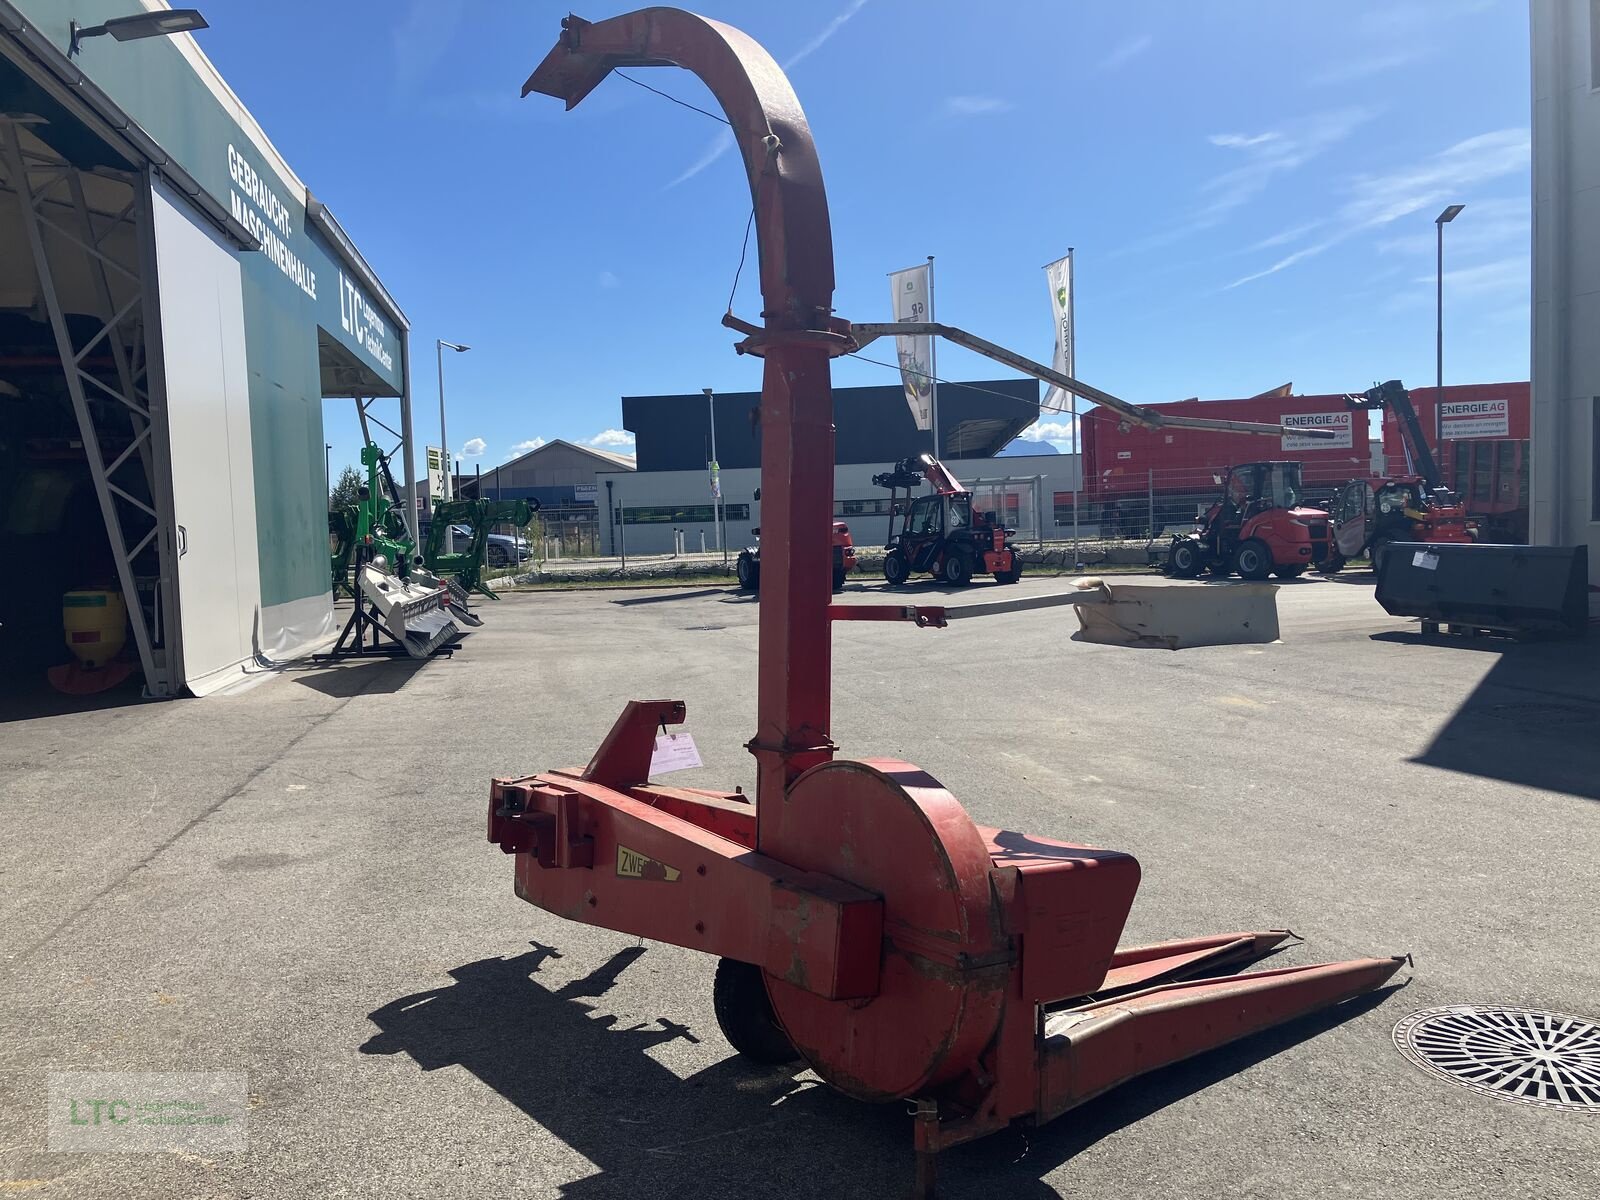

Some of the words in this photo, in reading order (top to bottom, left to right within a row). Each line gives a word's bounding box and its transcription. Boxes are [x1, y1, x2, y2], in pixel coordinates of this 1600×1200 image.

[228, 143, 292, 239] GEBRAUCHT-
[230, 189, 317, 301] MASCHINENHALLE
[339, 269, 363, 345] LTC
[1285, 415, 1333, 426] ENERGIE
